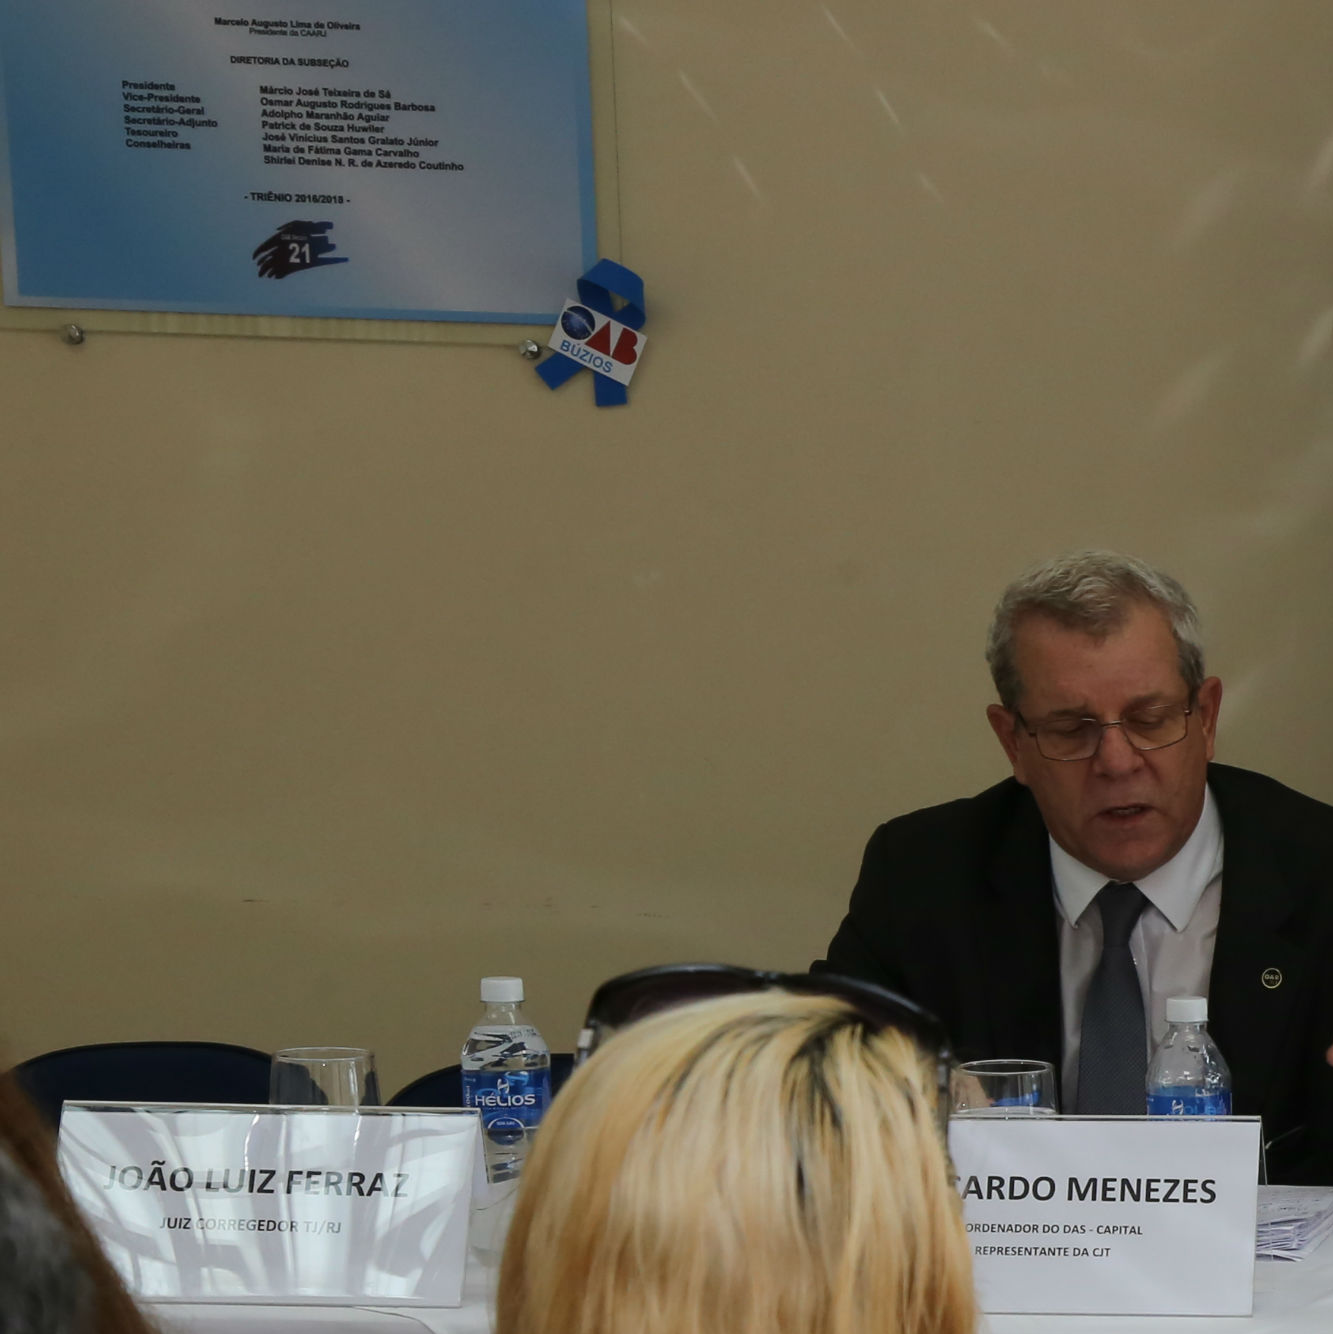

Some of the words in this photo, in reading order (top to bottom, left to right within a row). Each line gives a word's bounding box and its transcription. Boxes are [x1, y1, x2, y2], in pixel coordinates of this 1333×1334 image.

[214, 17, 249, 26] Marcelo
[251, 19, 288, 29] Augusto
[290, 21, 312, 29] Lima
[327, 22, 360, 31] Oliveira
[249, 28, 287, 36] Presidente
[230, 56, 280, 65] DIRETORIA
[282, 58, 295, 66] DA
[298, 57, 349, 69] SUBSEÇÃO
[122, 80, 175, 91] Presidente
[260, 86, 293, 95] Márcio
[296, 87, 319, 96] José
[322, 88, 360, 97] Teixeira
[363, 89, 376, 98] de
[122, 92, 201, 103] Vice-Presidente
[123, 104, 204, 115] Secretário-Geral
[261, 97, 293, 107] Osmar
[296, 99, 338, 110] Augusto
[340, 100, 391, 111] Rodrigues
[394, 102, 435, 112] Barbosa
[124, 115, 218, 128] Secretário-Adjunto
[261, 109, 303, 120] Adolpho
[306, 111, 354, 121] Maranhão
[357, 113, 390, 123] Aguiar
[125, 127, 178, 138] Tesoureiro
[262, 121, 297, 130] Patrick
[299, 122, 311, 131] de
[314, 122, 344, 132] Souza
[262, 132, 286, 141] José
[331, 135, 365, 144] Santos
[263, 144, 290, 153] Maria
[293, 145, 305, 154] de
[344, 147, 373, 156] Gama
[375, 148, 420, 158] Carvalho
[298, 156, 332, 166] Denise
[361, 159, 373, 168] de
[375, 160, 416, 170] Azeredo
[418, 161, 464, 172] Coutinho
[249, 191, 292, 202] TRIÊNIO
[289, 243, 311, 264] 21
[560, 340, 614, 373] BÚZIOS
[475, 1093, 536, 1107] HÉLIOS
[103, 1160, 194, 1193] JOÃO
[205, 1168, 276, 1194] LUIZ
[286, 1170, 410, 1198] FERRAZ
[955, 1175, 1056, 1201] ARDO
[1067, 1177, 1217, 1204] MENEZES
[160, 1217, 191, 1230] JUIZ
[195, 1217, 299, 1233] CORREGEDOR
[304, 1220, 341, 1235] TJ/RJ
[965, 1223, 1039, 1235] ORDENADOR
[1042, 1223, 1060, 1235] DO
[1063, 1224, 1086, 1235] DAS
[1096, 1225, 1143, 1236] CAPITAL
[974, 1246, 1069, 1258] REPRESENTANTE
[1072, 1247, 1089, 1257] DA
